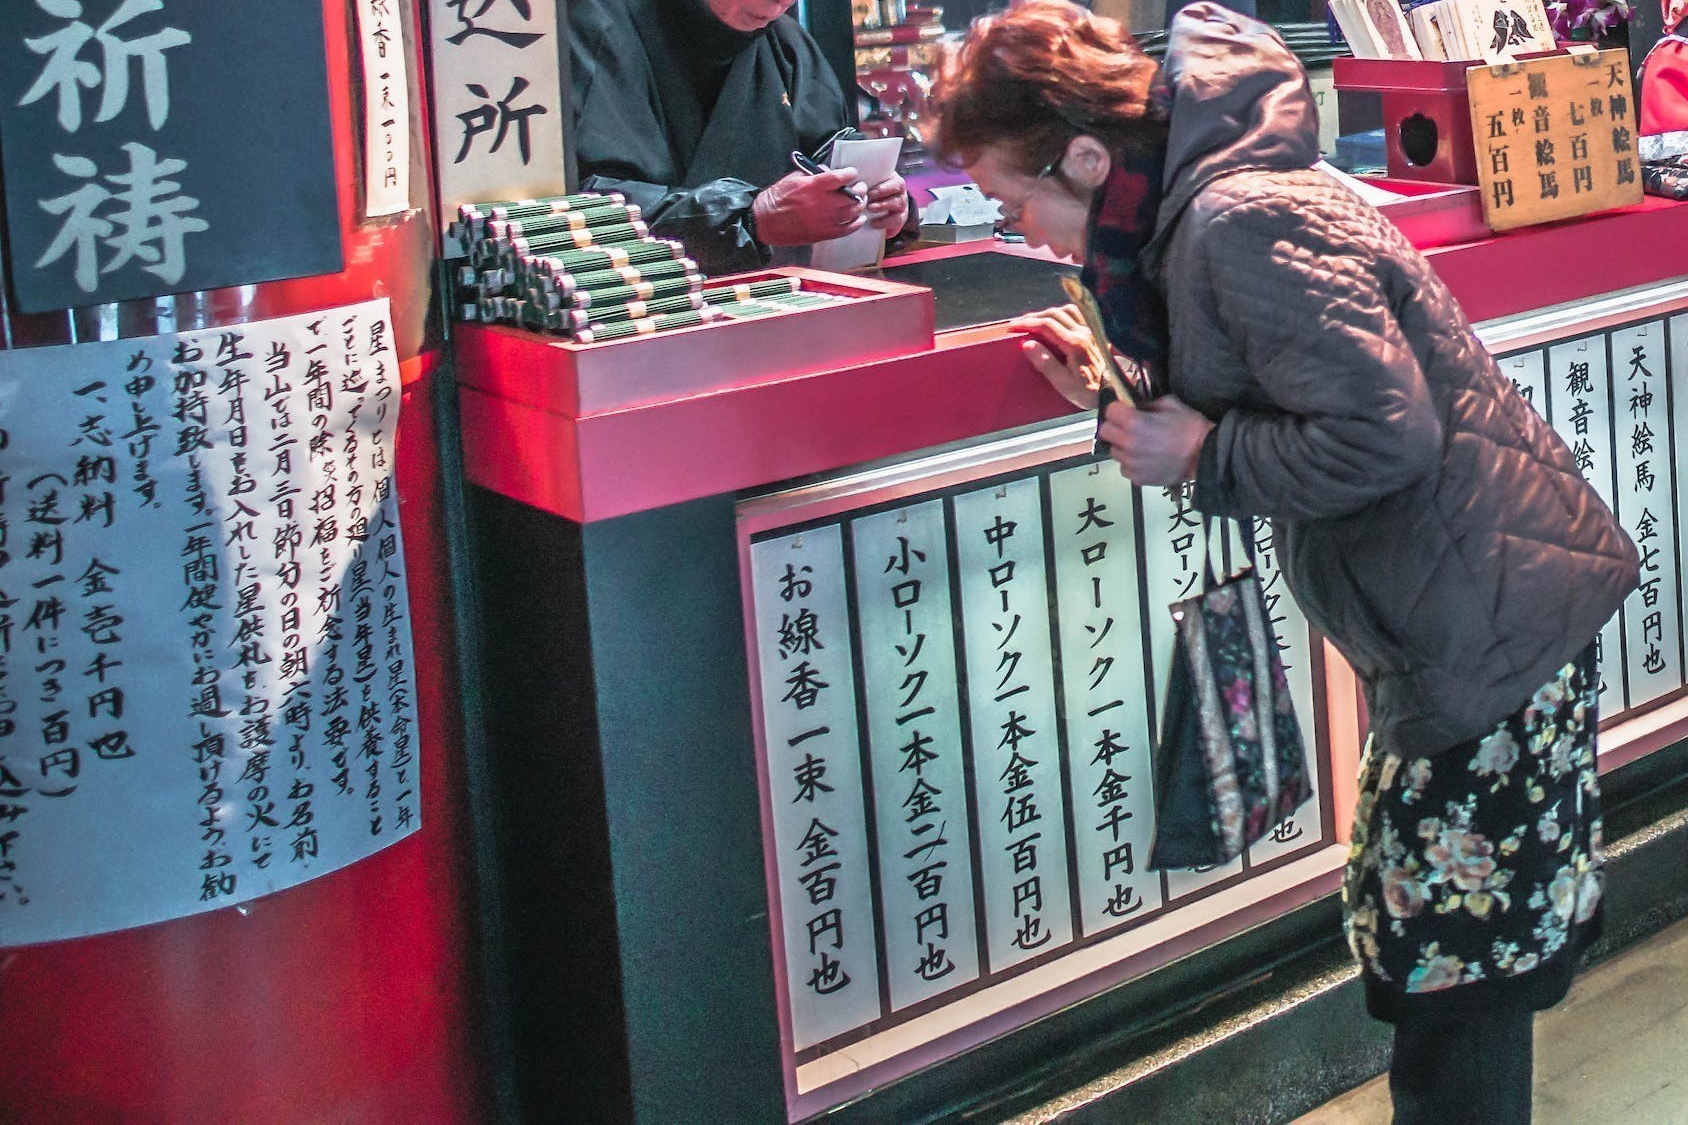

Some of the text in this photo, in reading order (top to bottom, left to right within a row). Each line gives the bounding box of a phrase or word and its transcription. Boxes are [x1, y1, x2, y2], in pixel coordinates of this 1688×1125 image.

[1485, 110, 1515, 209] 五百円
[1508, 89, 1526, 127] 一枚
[1568, 101, 1594, 194] 七百円
[1602, 61, 1636, 186] 天神絵馬
[119, 349, 162, 509] め申し上げます。
[1073, 495, 1143, 918] 大ローソク一本金千円也
